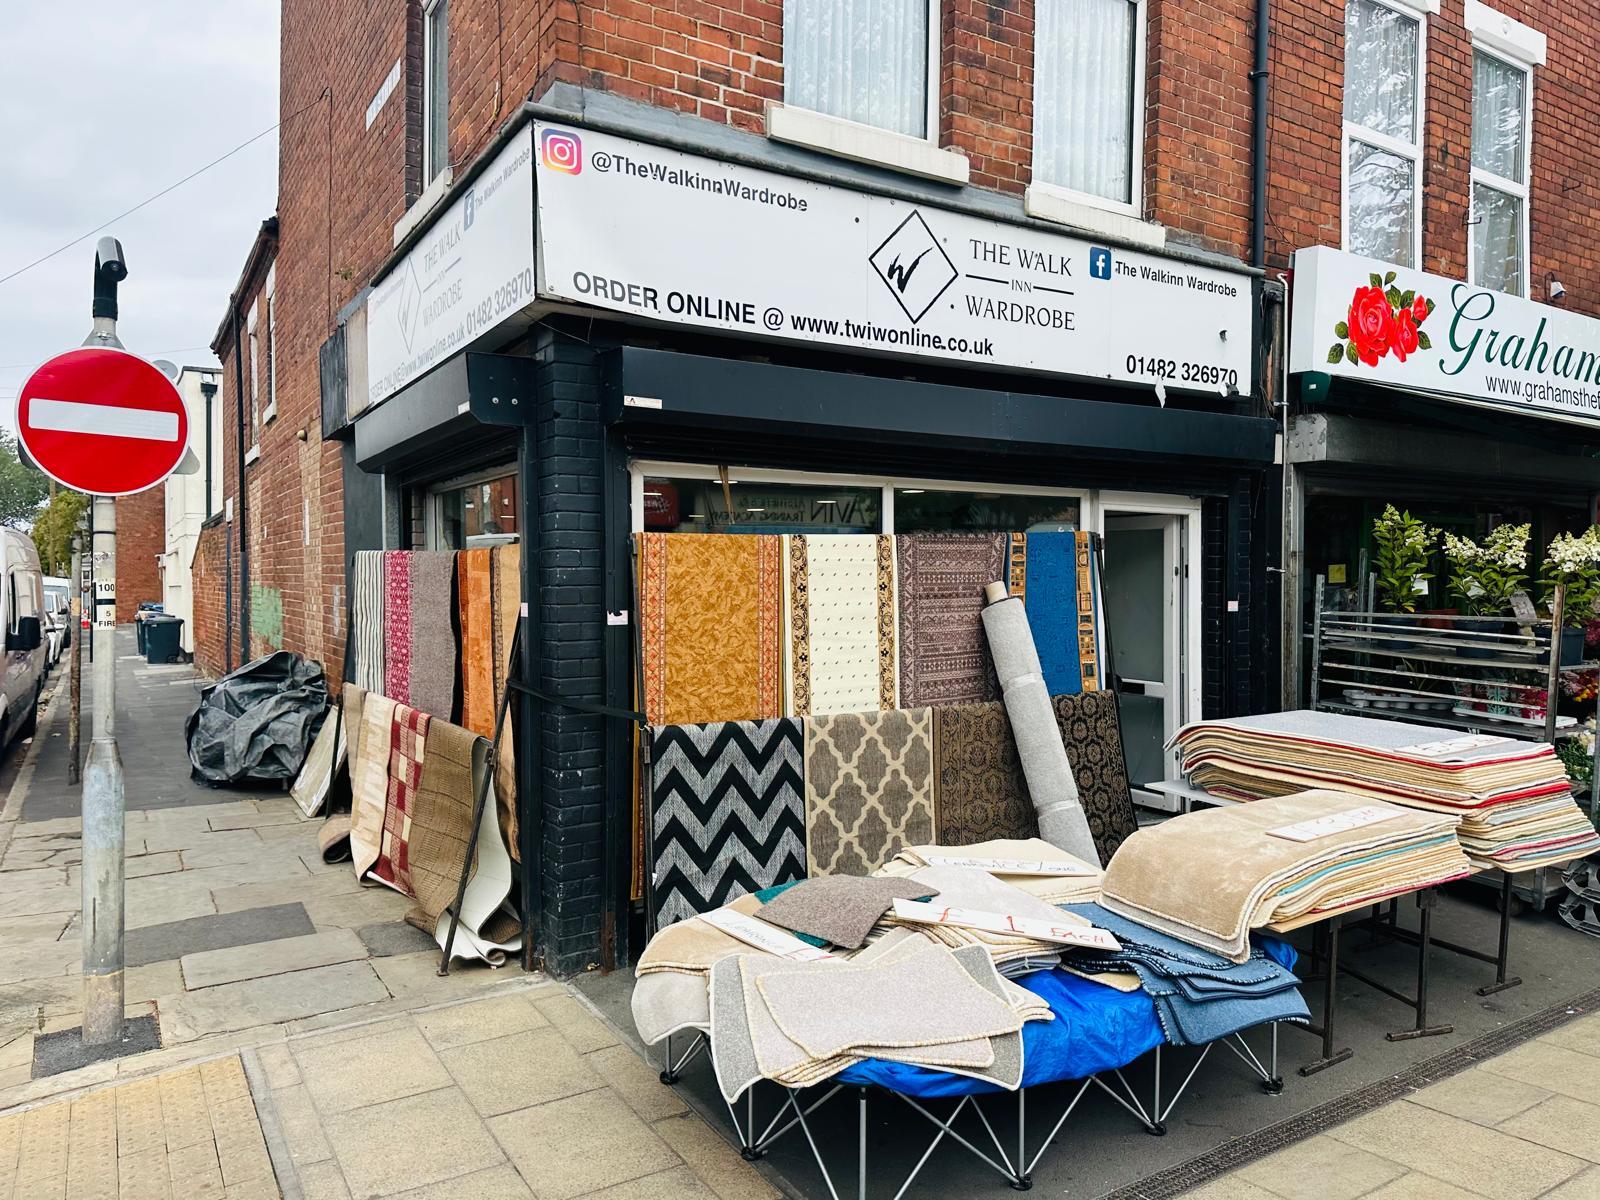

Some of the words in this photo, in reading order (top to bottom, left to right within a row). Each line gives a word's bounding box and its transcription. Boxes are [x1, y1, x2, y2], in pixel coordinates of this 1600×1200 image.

[502, 148, 531, 181] Wardrobe
[591, 151, 808, 211] @TheWalkinnWardrobe
[424, 244, 438, 273] THE
[439, 223, 461, 258] WALK
[970, 239, 1010, 265] THE
[1017, 247, 1072, 277] WALK
[1011, 279, 1032, 293] INN
[1115, 261, 1136, 277] The
[1140, 266, 1183, 287] Walkinn
[1187, 276, 1237, 298] Wardrobe
[423, 279, 463, 327] WARDROBE
[466, 296, 492, 335] 01482
[494, 267, 532, 316] 326970
[573, 271, 658, 309] ORDER
[667, 291, 756, 324] ONLINE
[763, 307, 784, 331] @
[791, 314, 994, 357] www.twiwonline.co.uk
[965, 295, 1075, 331] WARDROBE
[1126, 354, 1177, 379] 01482
[1181, 362, 1238, 386] 326970
